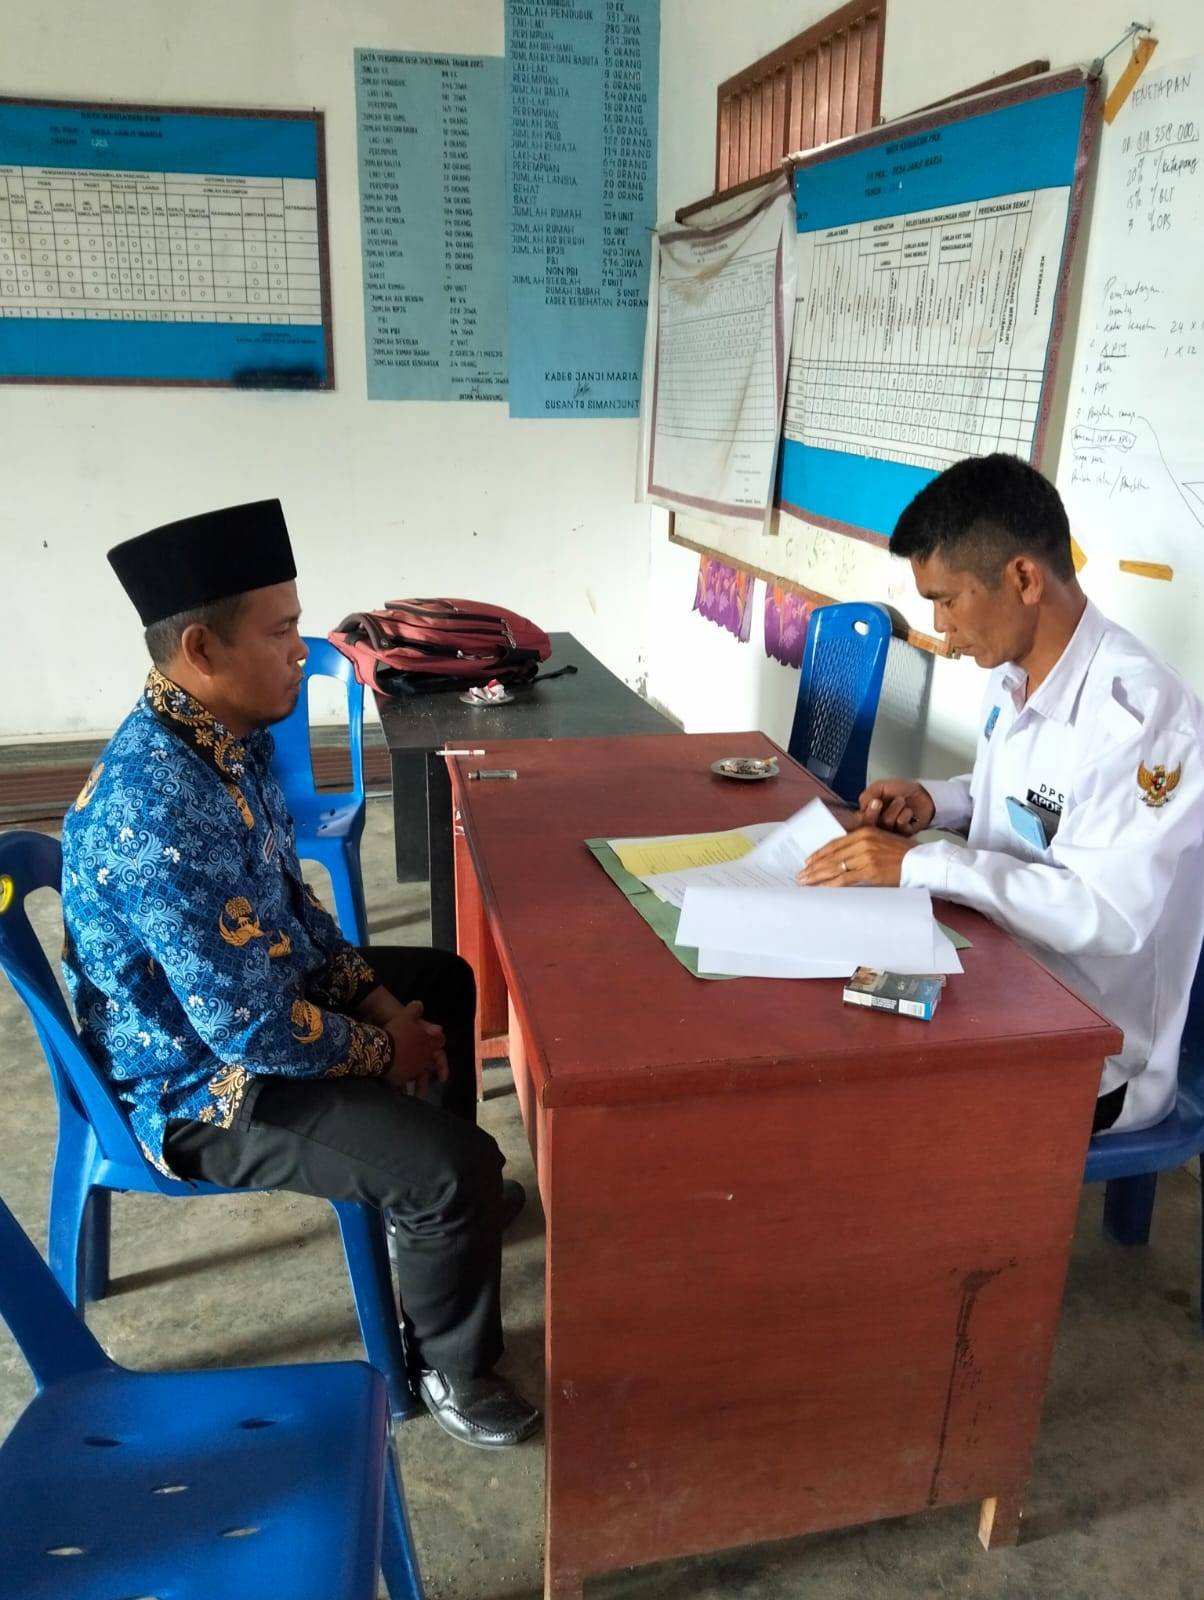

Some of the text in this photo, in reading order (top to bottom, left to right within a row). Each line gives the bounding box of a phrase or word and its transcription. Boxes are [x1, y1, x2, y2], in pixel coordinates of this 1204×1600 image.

[511, 6, 593, 20] JUMLAH PENDUDUK
[511, 207, 582, 219] JUMLAH RUMAH
[575, 371, 604, 382] JANJI
[606, 371, 639, 382] MARIA
[545, 399, 585, 410] SUSANTO
